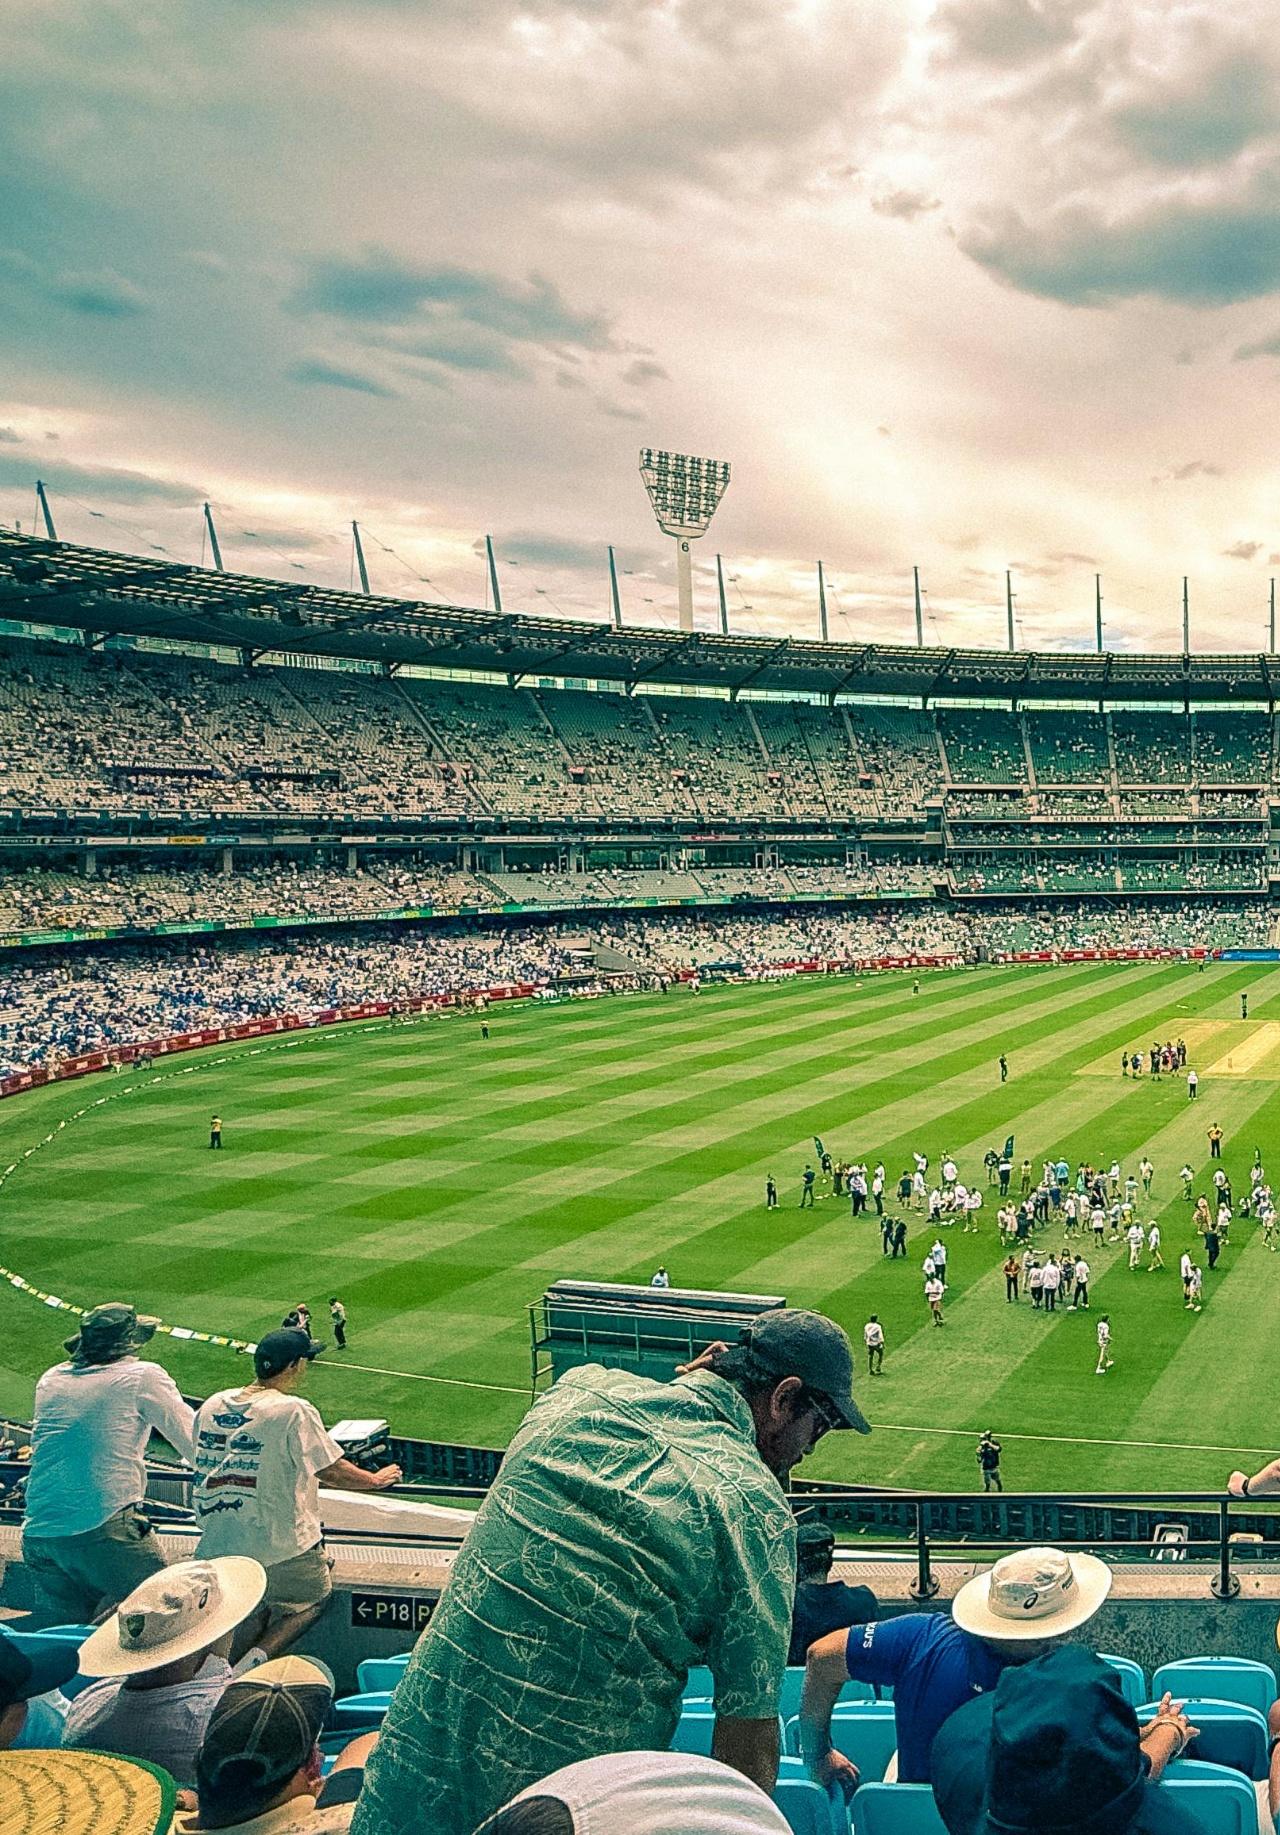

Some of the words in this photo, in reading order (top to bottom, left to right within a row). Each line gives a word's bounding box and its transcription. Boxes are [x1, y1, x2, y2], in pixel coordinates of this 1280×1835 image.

[307, 916, 336, 924] PARTNER
[376, 1602, 410, 1621] P18
[418, 1605, 432, 1622] P
